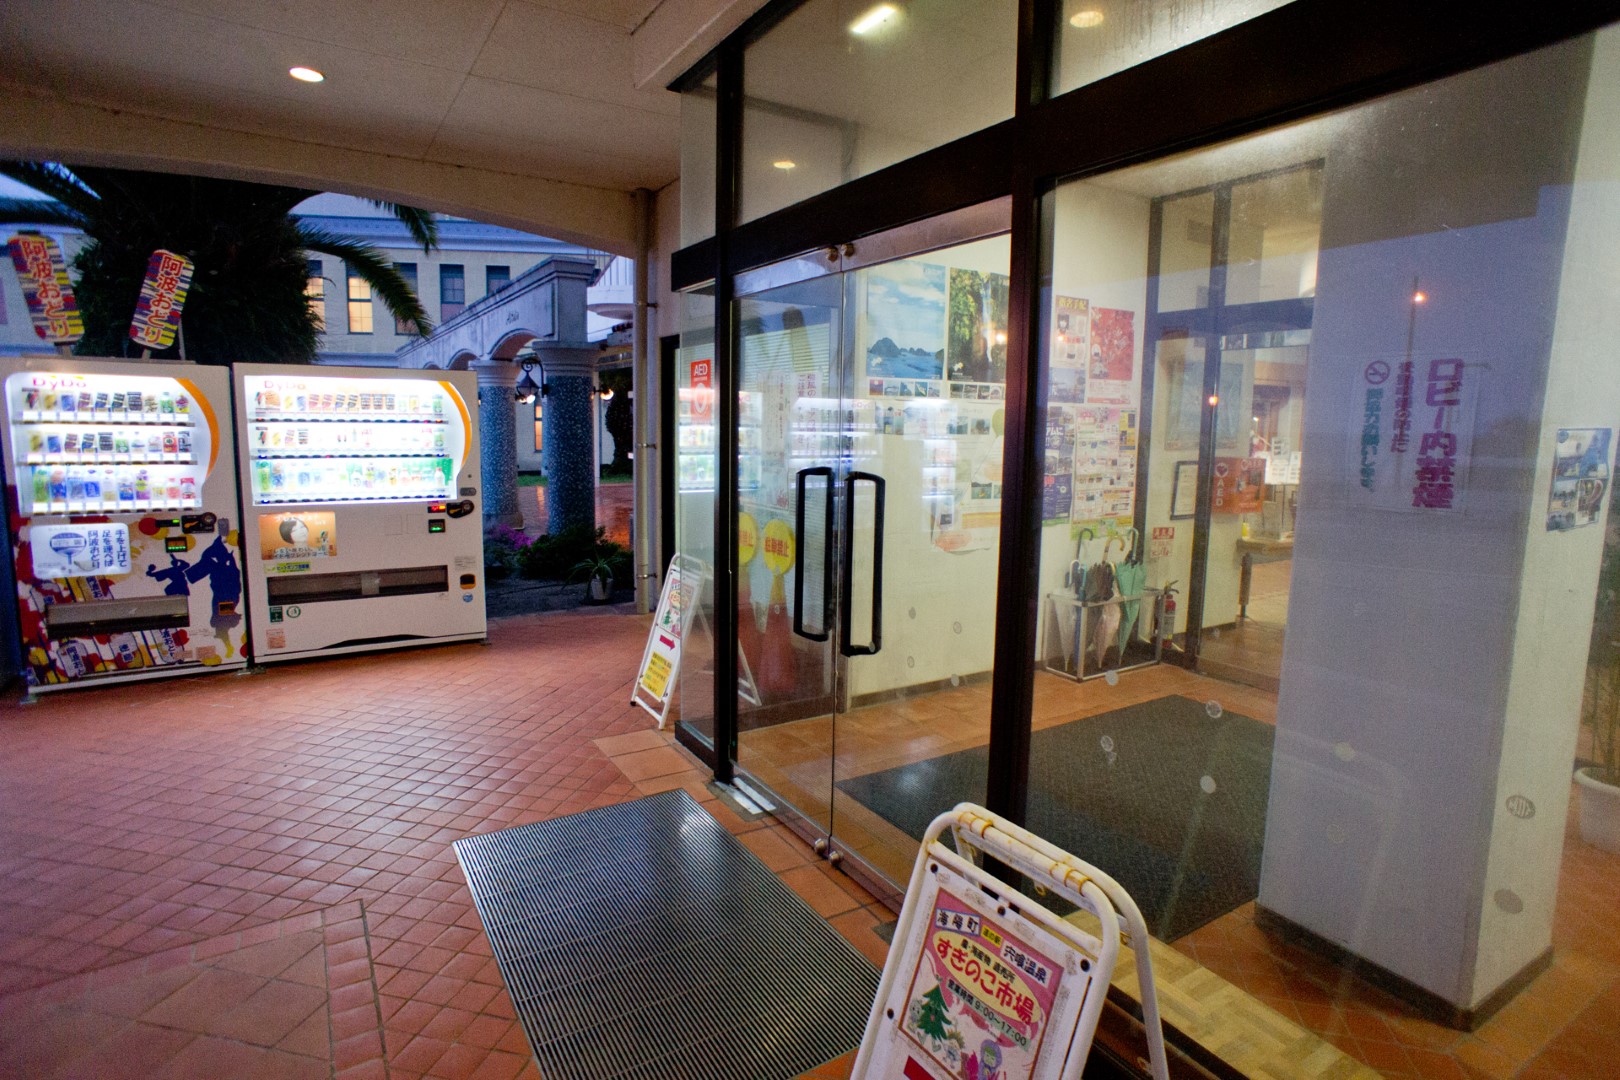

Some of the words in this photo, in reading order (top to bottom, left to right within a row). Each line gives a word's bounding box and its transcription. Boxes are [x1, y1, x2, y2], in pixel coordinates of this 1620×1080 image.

[21, 240, 70, 338] 阿波おどり
[144, 255, 184, 343] 阿波おどり
[32, 376, 87, 390] DyDo
[264, 380, 307, 390] DyDo
[694, 363, 708, 376] AED
[1412, 358, 1465, 509] ロビー内禁煙
[88, 529, 101, 569] 阿波おどり
[115, 528, 127, 567] 手を上げて
[764, 537, 789, 558] 駐車禁止
[937, 910, 979, 933] 海陽町
[983, 927, 1002, 945] 道の駅
[1003, 944, 1047, 984] 宍喰温泉
[936, 937, 1036, 1026] すぎのこ市場
[947, 979, 975, 1008] 営業時間
